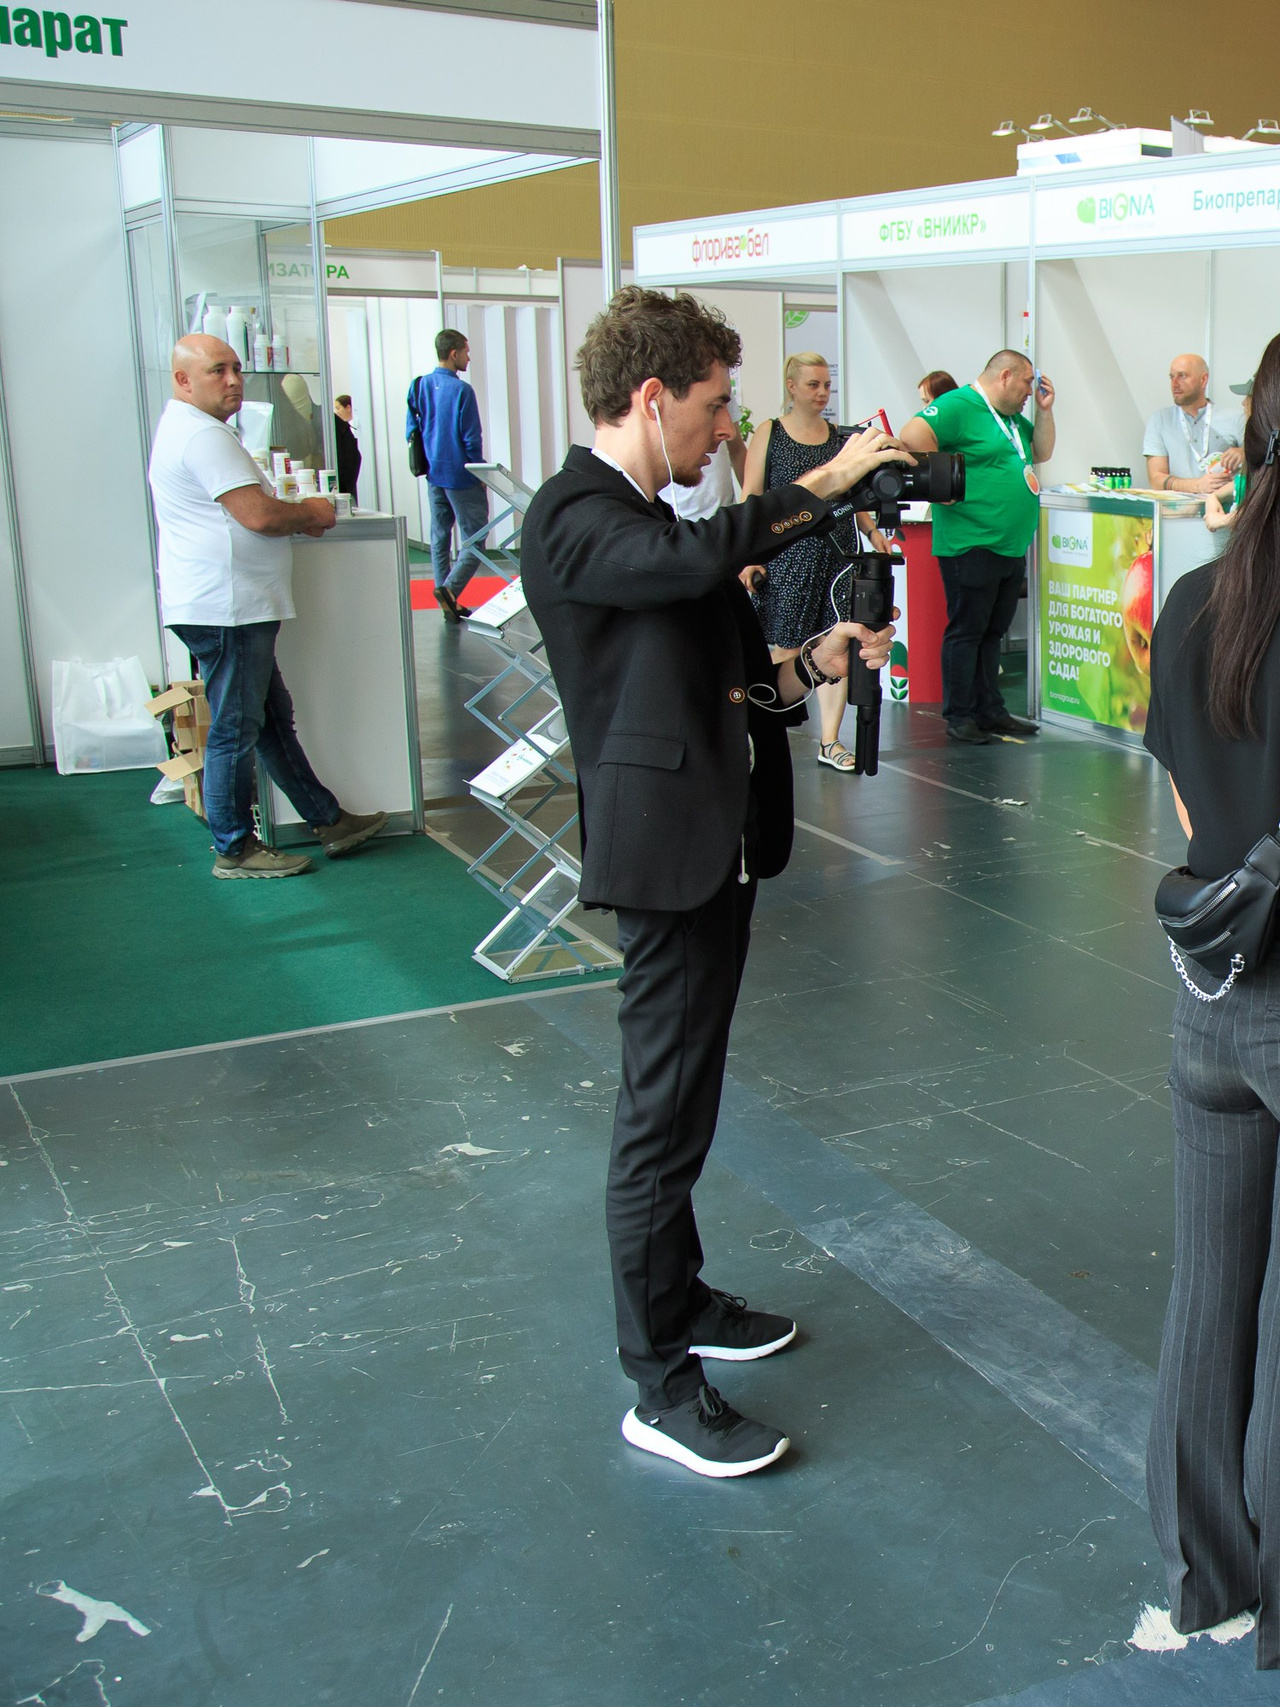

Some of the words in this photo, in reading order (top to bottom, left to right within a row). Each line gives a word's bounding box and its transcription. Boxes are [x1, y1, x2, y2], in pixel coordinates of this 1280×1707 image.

[1099, 193, 1155, 221] BIONA
[879, 219, 913, 242] ФГБУ
[917, 213, 987, 239] «ВНИИКР»
[832, 502, 854, 518] RONIN
[1048, 580, 1070, 598] ВАШ
[1072, 584, 1118, 606] ПАРТНЕР
[1048, 600, 1069, 618] ДЛЯ
[1070, 604, 1123, 628] БОГАТОГО
[1048, 620, 1091, 643] УРОЖАЯ
[1093, 629, 1101, 645] И
[1048, 640, 1111, 667] ЗДОРОВОГО
[1048, 660, 1080, 681] САДА!
